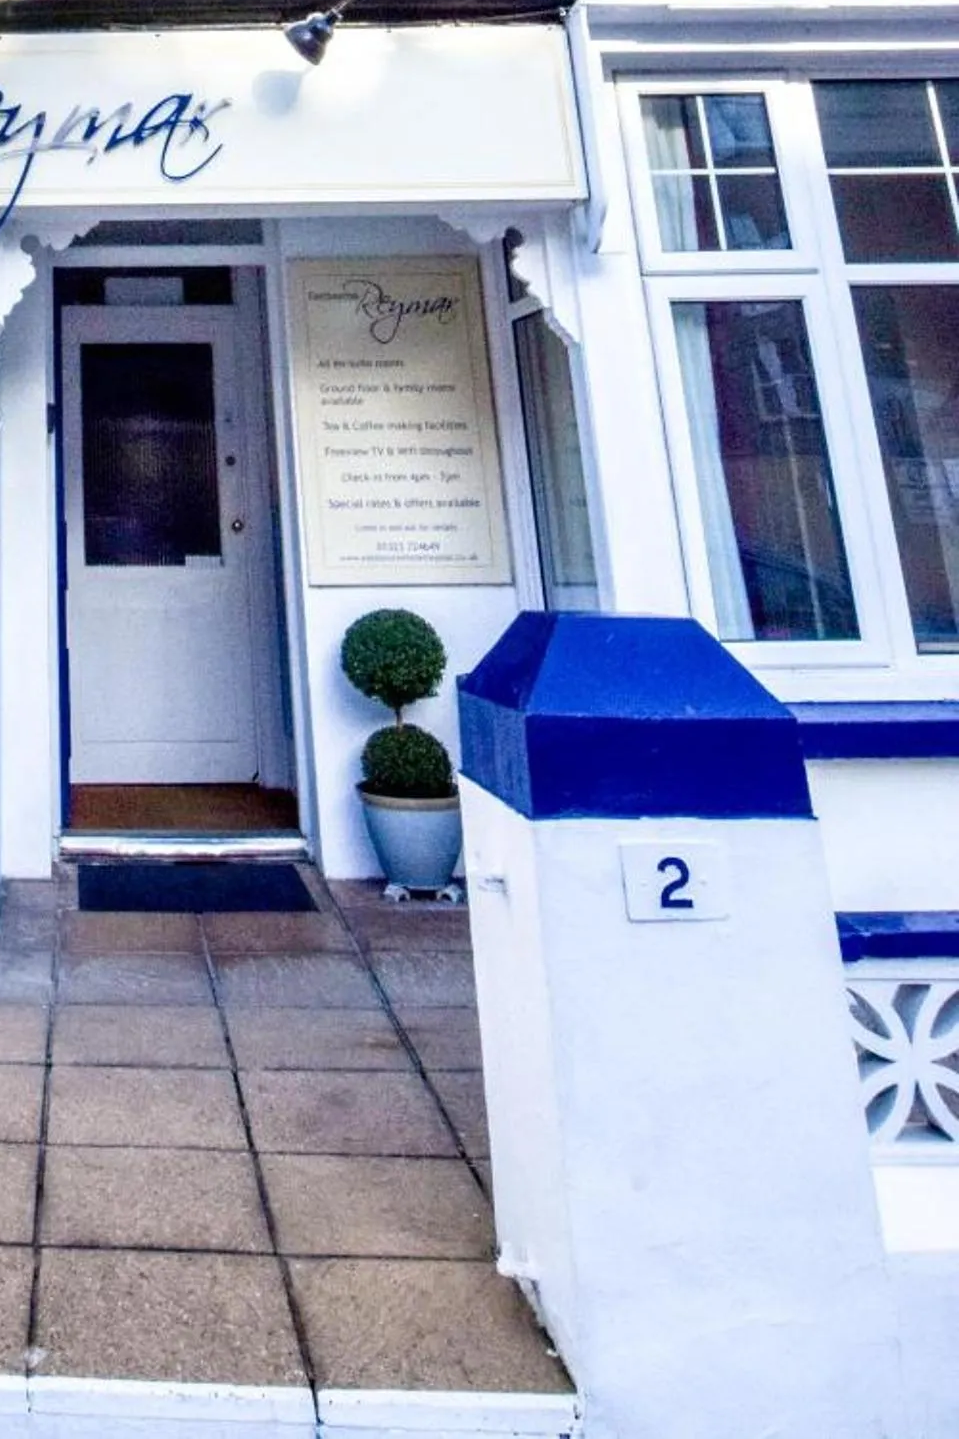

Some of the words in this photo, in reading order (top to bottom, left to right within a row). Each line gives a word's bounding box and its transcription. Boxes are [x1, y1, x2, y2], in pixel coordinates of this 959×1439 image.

[342, 279, 460, 344] Reymar
[320, 384, 355, 393] Ground
[358, 384, 379, 393] floor
[394, 384, 425, 394] family
[427, 385, 455, 393] rooms
[321, 397, 364, 406] available
[322, 421, 340, 430] Tea
[352, 421, 384, 431] Coffee
[387, 421, 422, 432] making
[425, 421, 468, 431] facilities
[325, 447, 368, 456] Freeview
[372, 447, 384, 456] TV
[328, 498, 363, 509] Special
[366, 499, 391, 508] rates
[404, 498, 432, 508] offers
[435, 498, 481, 508] available
[657, 856, 694, 909] 2
